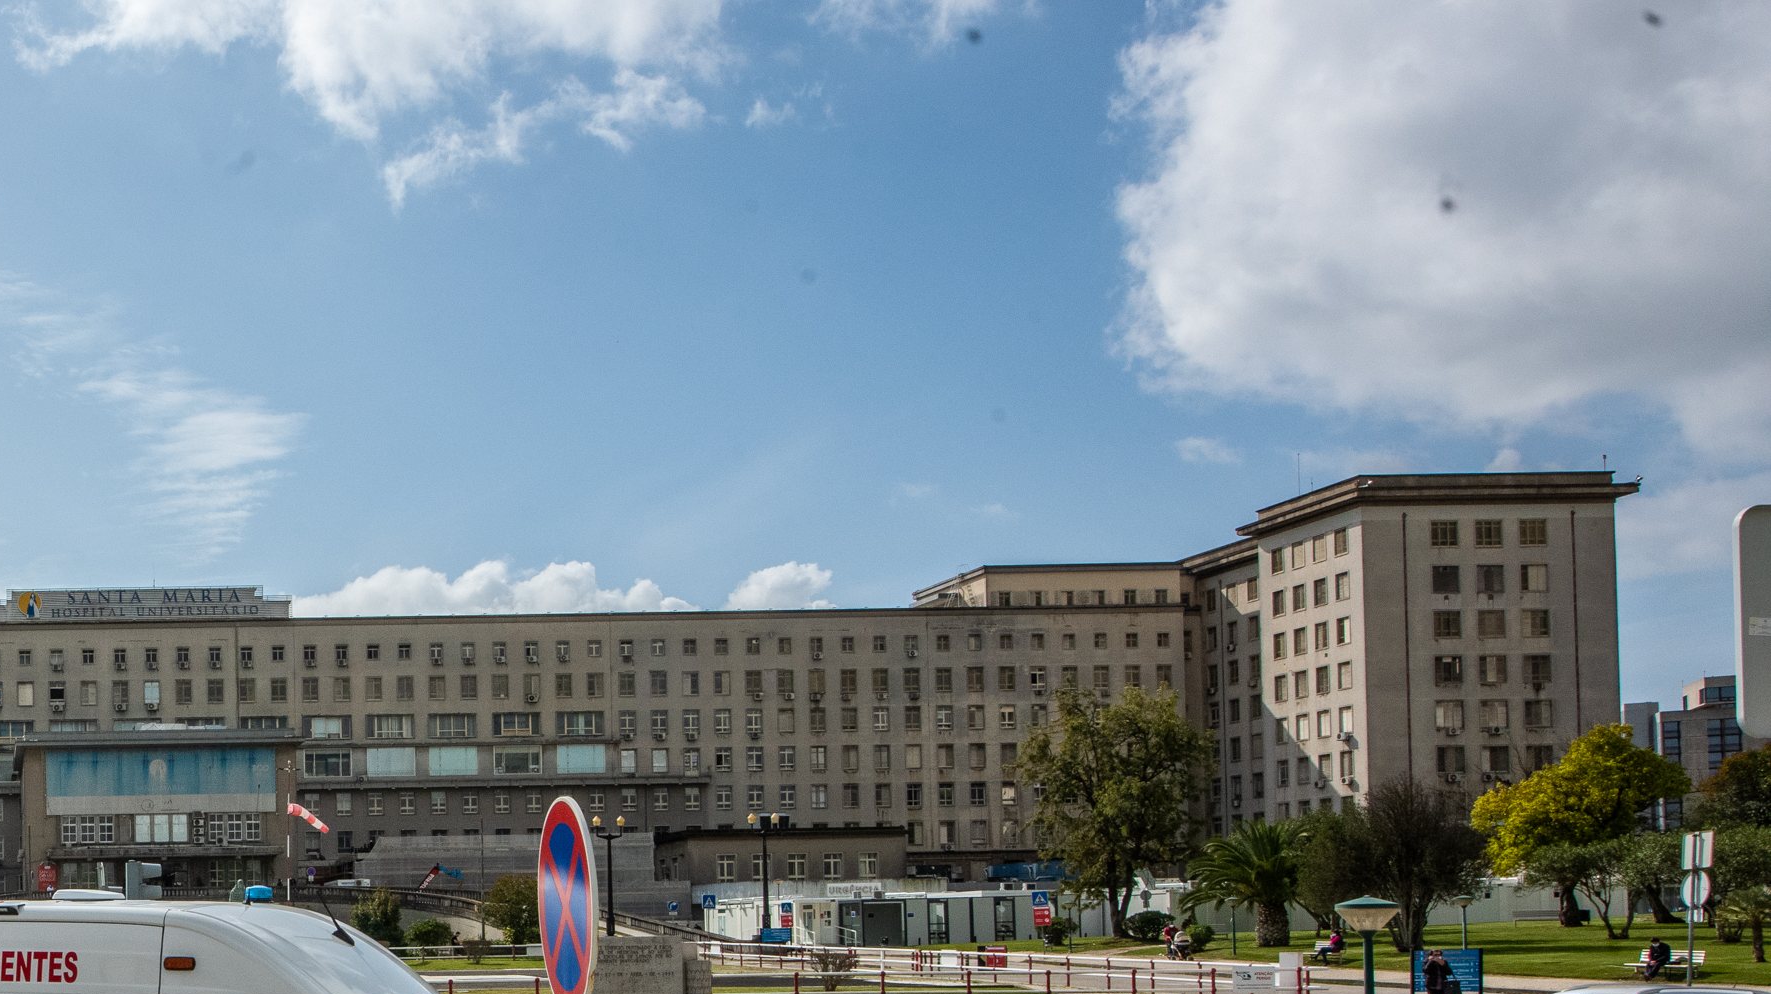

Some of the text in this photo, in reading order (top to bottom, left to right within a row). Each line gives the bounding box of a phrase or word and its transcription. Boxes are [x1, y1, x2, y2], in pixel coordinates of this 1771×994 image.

[67, 588, 241, 605] SANTA MARIA
[51, 604, 259, 619] HOSPITAL UNIVERSITÁRIO
